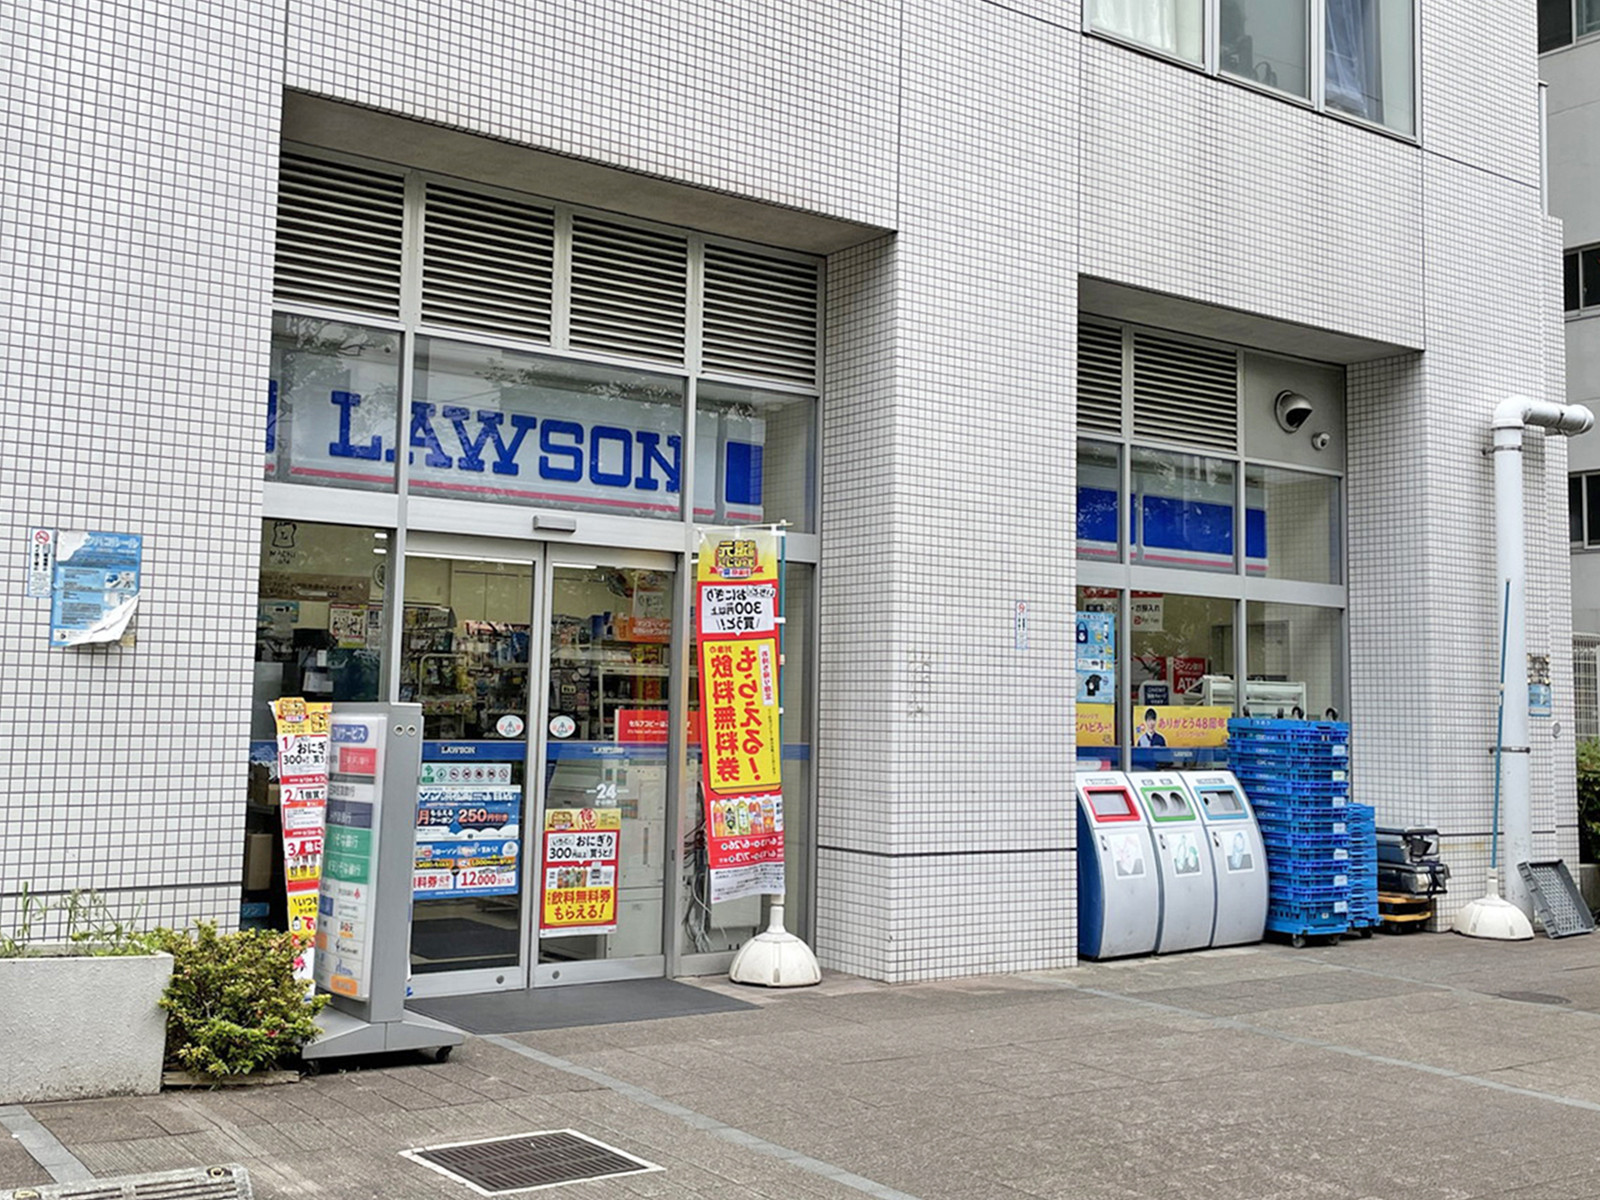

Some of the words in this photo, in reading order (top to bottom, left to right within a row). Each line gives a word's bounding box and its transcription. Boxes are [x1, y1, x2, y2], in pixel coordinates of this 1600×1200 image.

[328, 391, 682, 493] LAWSON
[1158, 717, 1226, 730] ありがとう48周年
[282, 736, 289, 750] 1
[441, 745, 476, 754] LAWSON
[285, 790, 292, 805] 2
[596, 784, 617, 799] 24
[576, 835, 614, 847] おにぎり
[288, 843, 297, 857] 3
[551, 889, 611, 905] 飲料無料券
[553, 904, 604, 920] もらえる!
